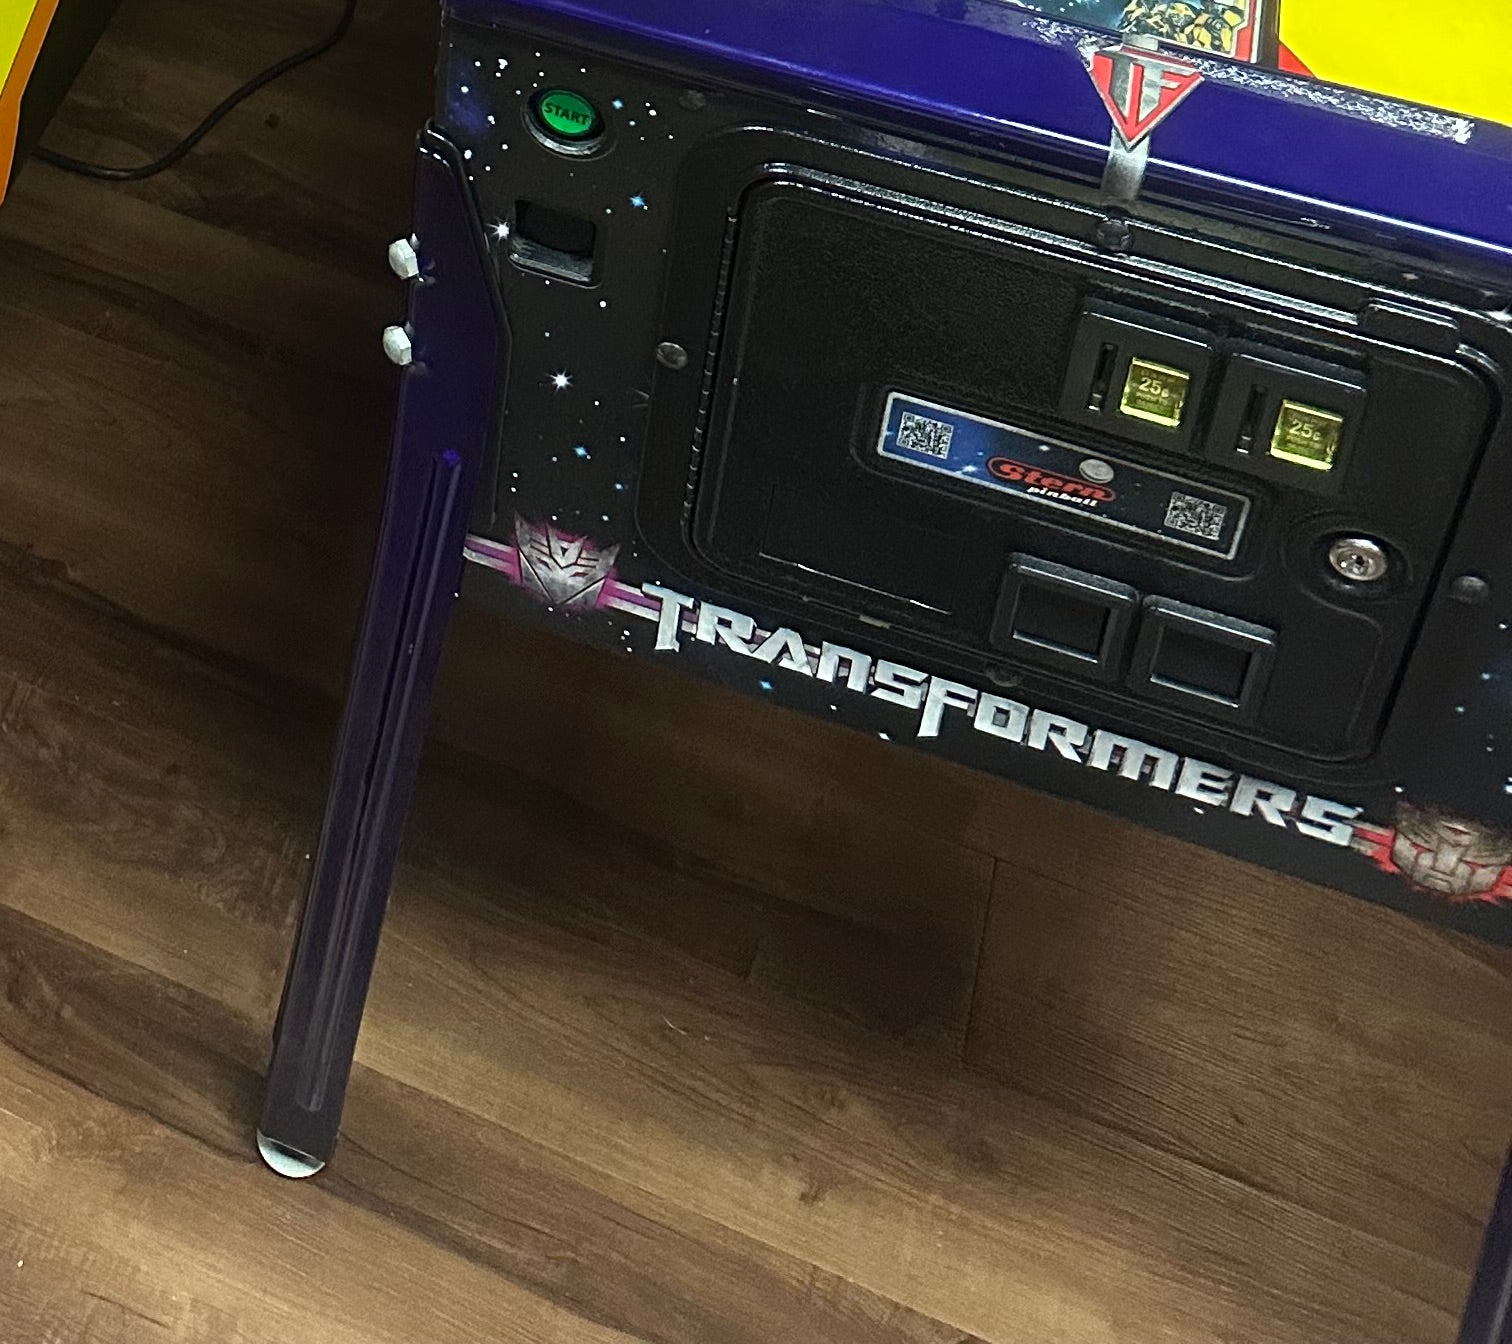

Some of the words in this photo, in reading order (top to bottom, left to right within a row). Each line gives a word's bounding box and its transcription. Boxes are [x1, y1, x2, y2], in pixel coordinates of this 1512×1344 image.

[544, 102, 590, 125] START
[1000, 462, 1106, 501] Stern
[1026, 485, 1101, 509] pinball
[641, 579, 1364, 850] TRANSFORMERS
